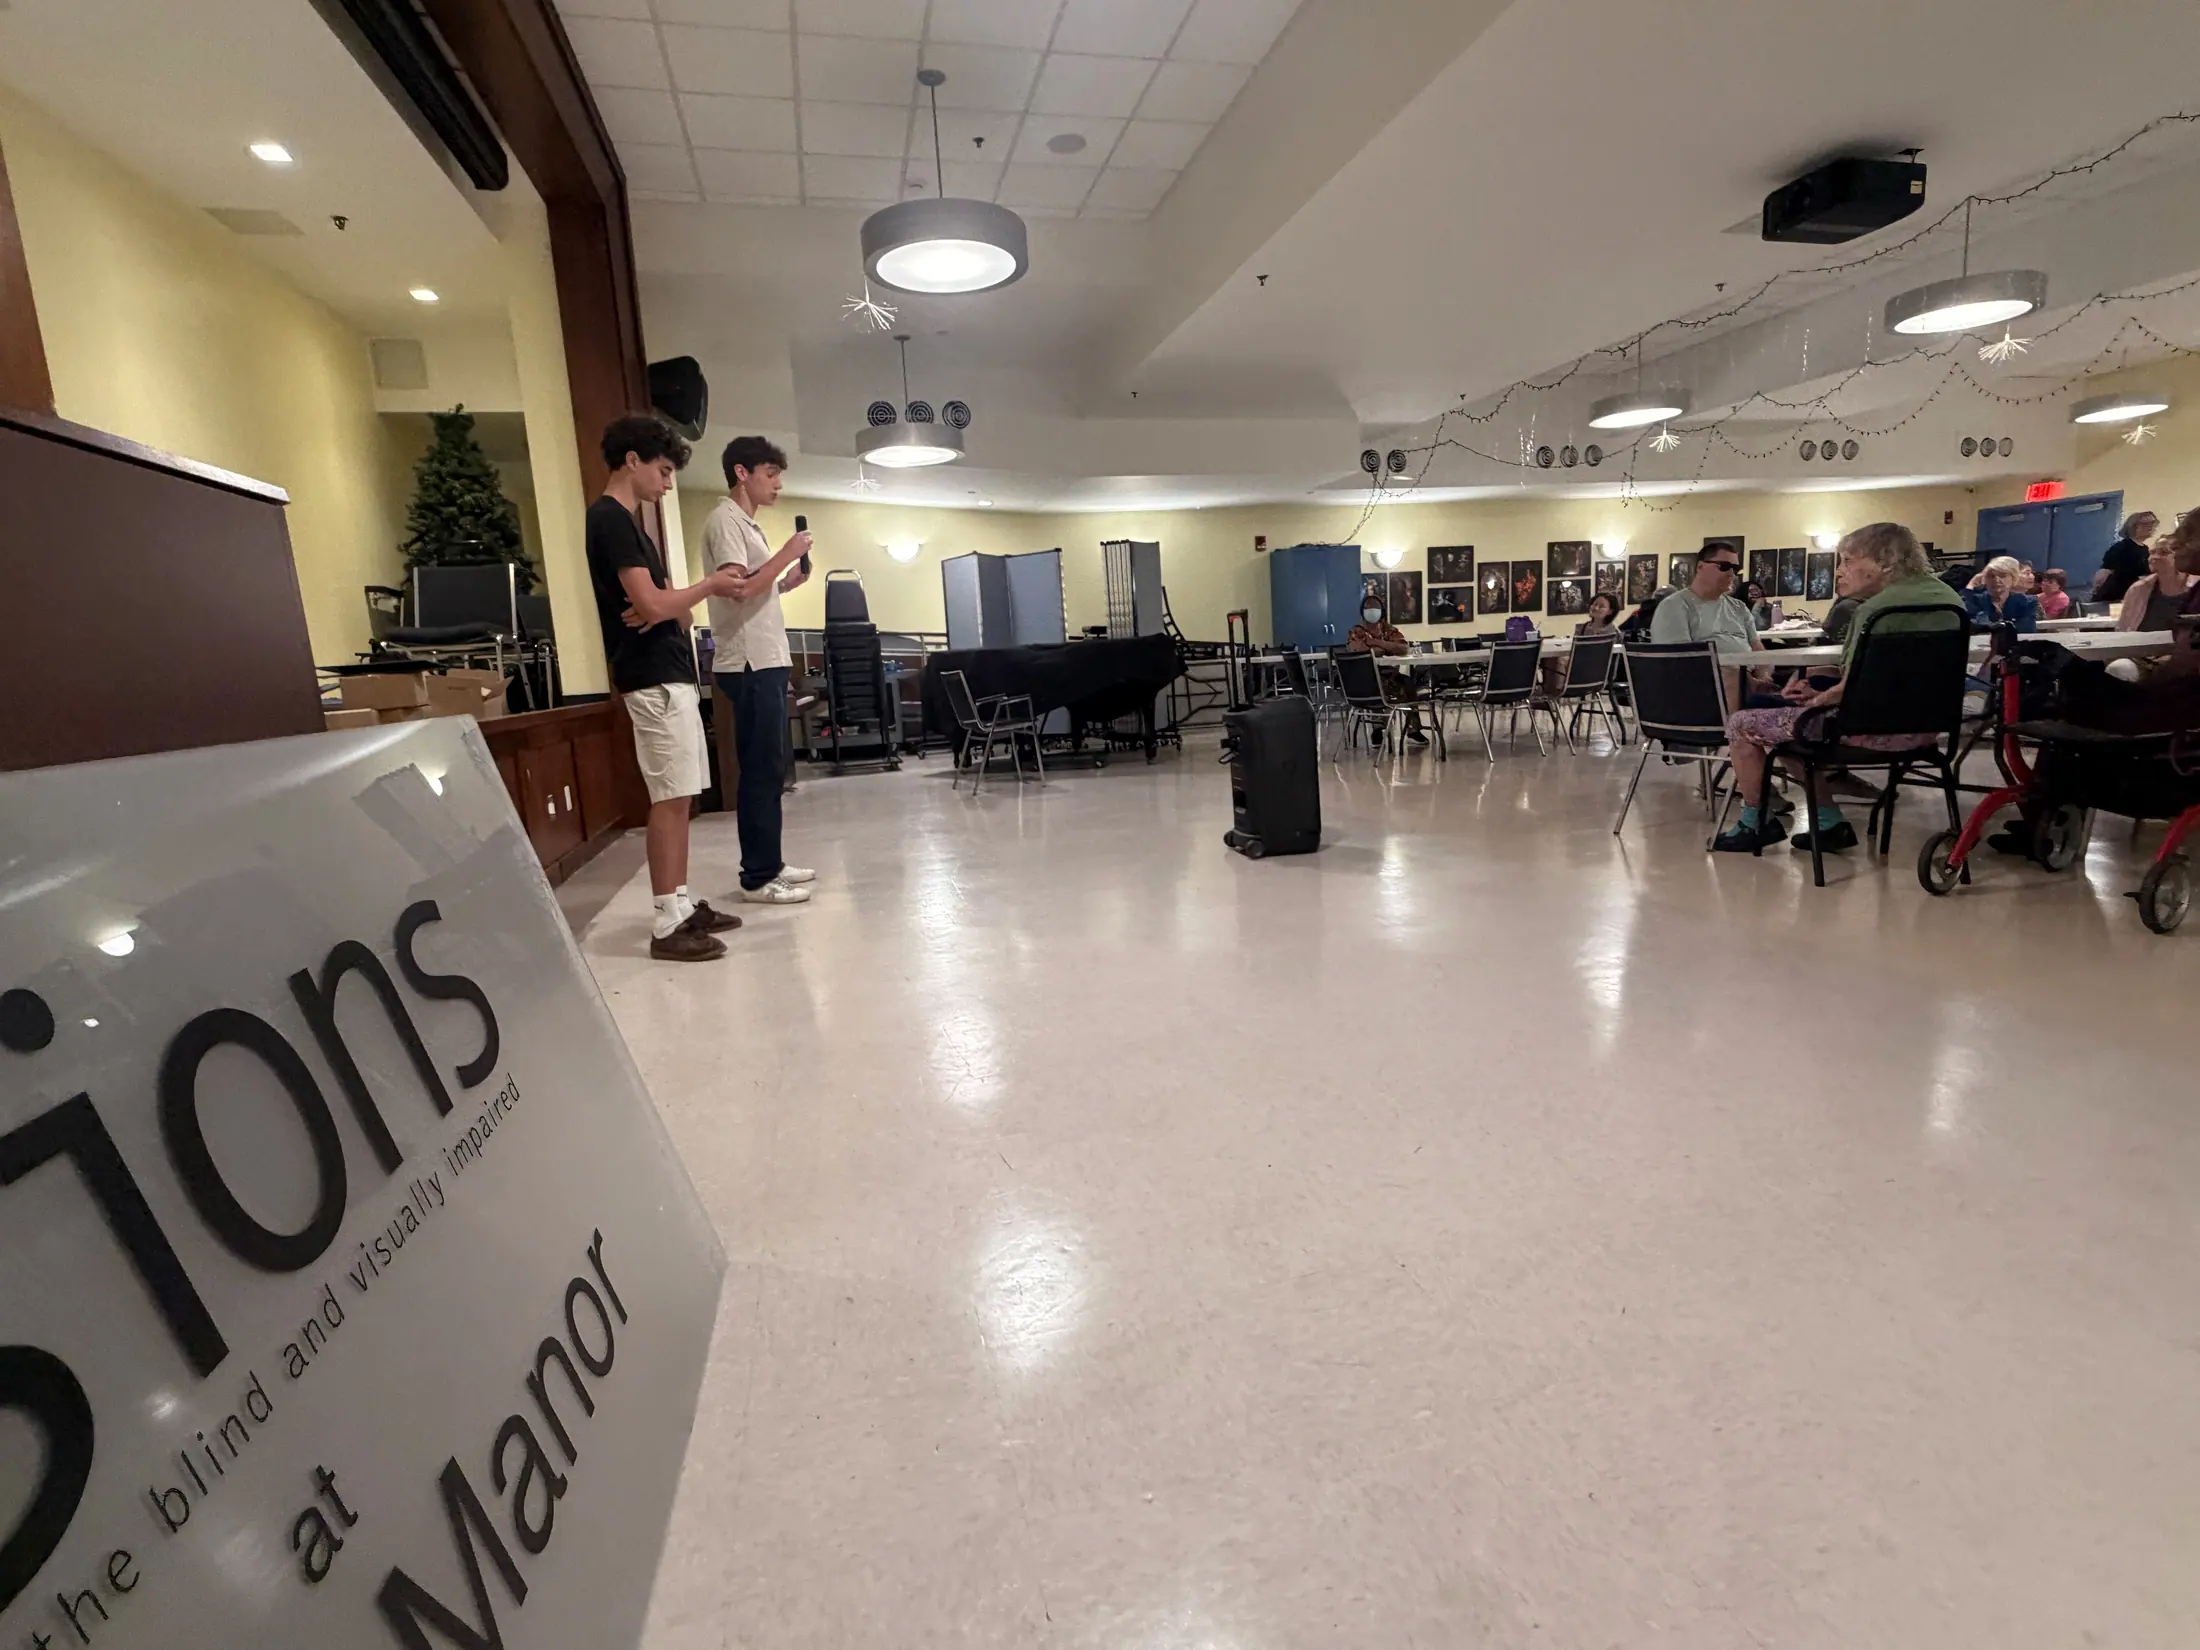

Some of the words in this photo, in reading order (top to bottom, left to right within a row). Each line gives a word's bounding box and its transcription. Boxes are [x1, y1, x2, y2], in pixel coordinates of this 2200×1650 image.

[0, 900, 500, 1613] ions
[149, 1369, 273, 1533] blind
[283, 1282, 346, 1379] and
[349, 1171, 445, 1292] visually
[442, 1072, 521, 1177] impaired
[374, 1227, 629, 1650] Manor
[292, 1464, 359, 1583] at
